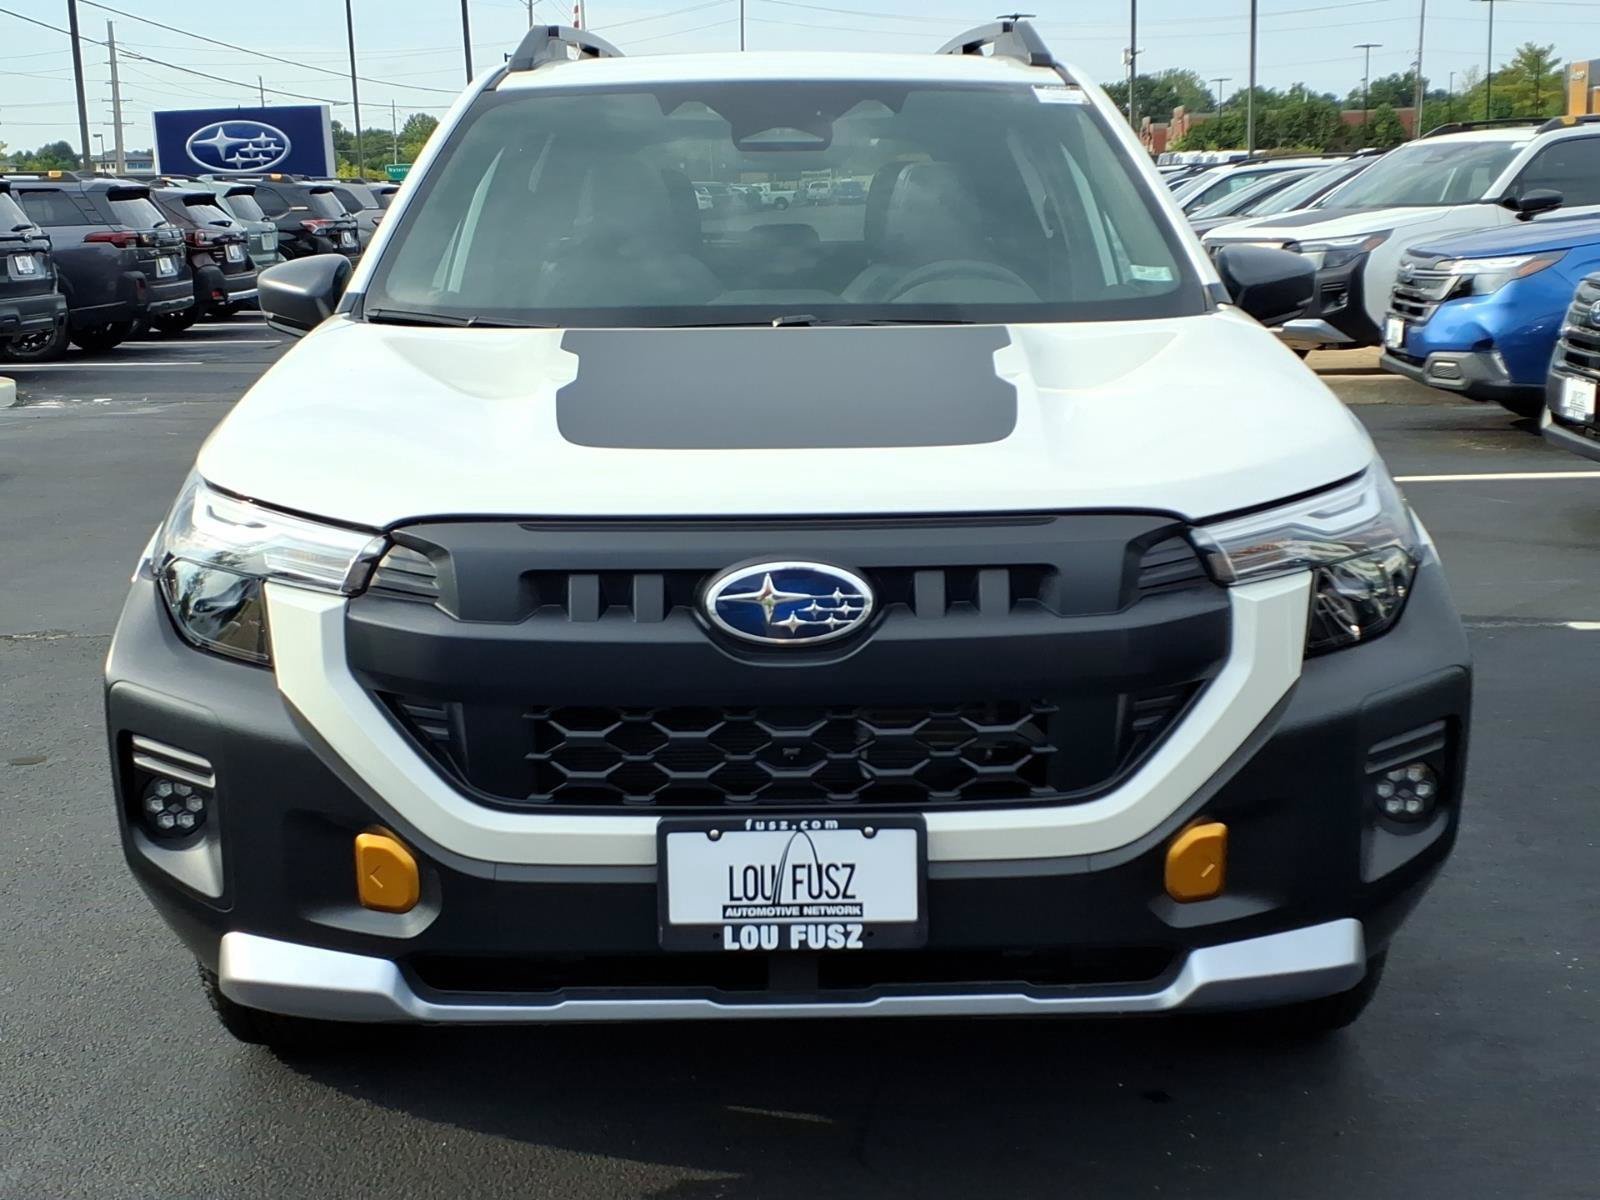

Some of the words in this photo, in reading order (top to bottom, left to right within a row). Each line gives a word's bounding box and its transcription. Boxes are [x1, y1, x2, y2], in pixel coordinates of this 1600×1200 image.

[745, 818, 839, 830] fusz.com
[729, 864, 776, 901] LOU
[792, 863, 856, 899] FUSZ
[725, 906, 799, 917] AUTOMOTIVE
[803, 905, 861, 916] NETWORK
[724, 925, 779, 950] LOU
[791, 924, 864, 949] FUSZ
